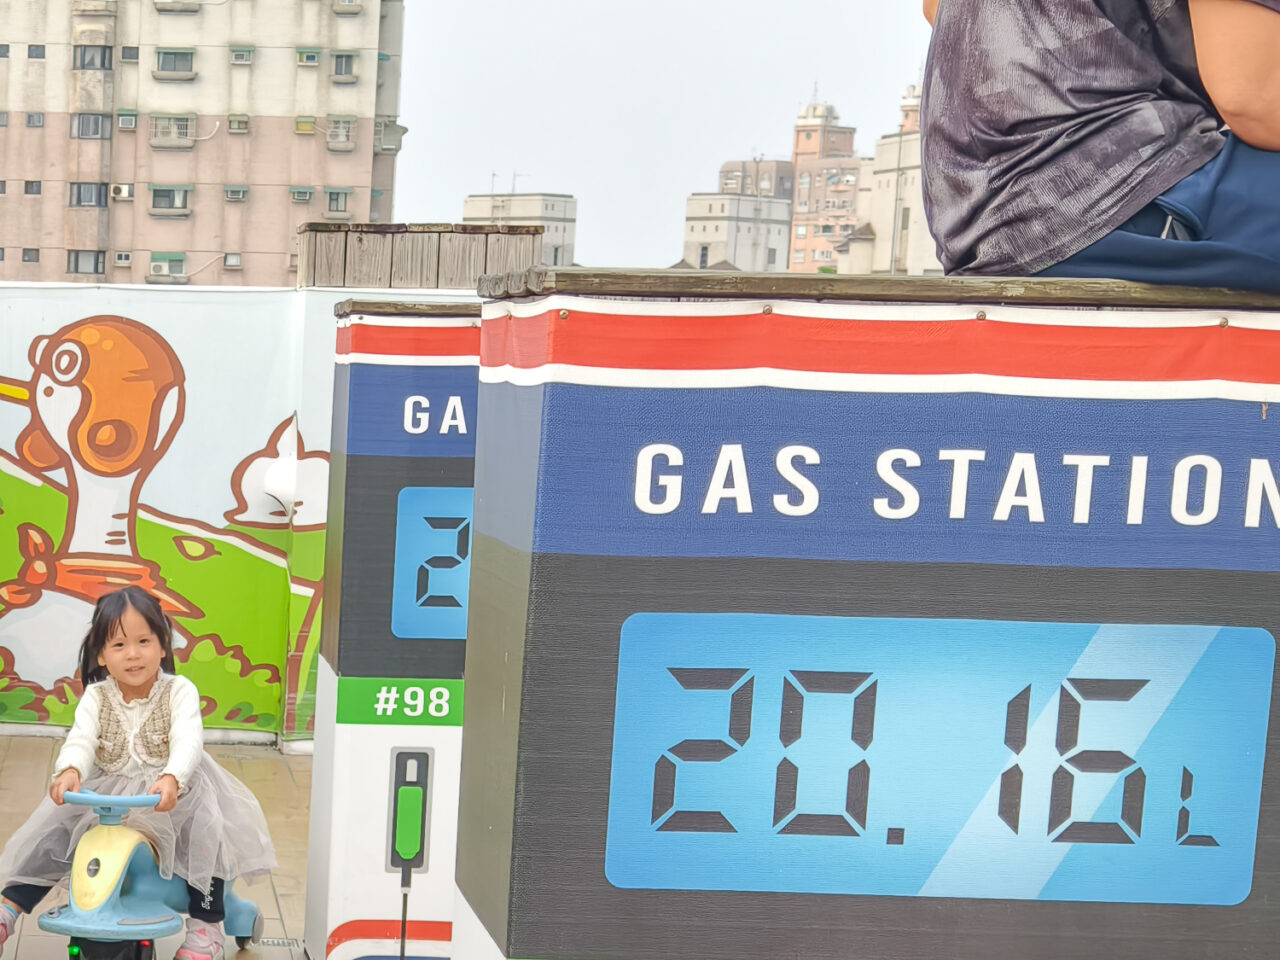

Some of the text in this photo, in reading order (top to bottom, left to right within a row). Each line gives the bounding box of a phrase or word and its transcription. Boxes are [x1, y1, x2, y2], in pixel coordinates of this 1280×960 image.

[633, 442, 1280, 530] GAS STATION
[373, 686, 450, 718] #98
